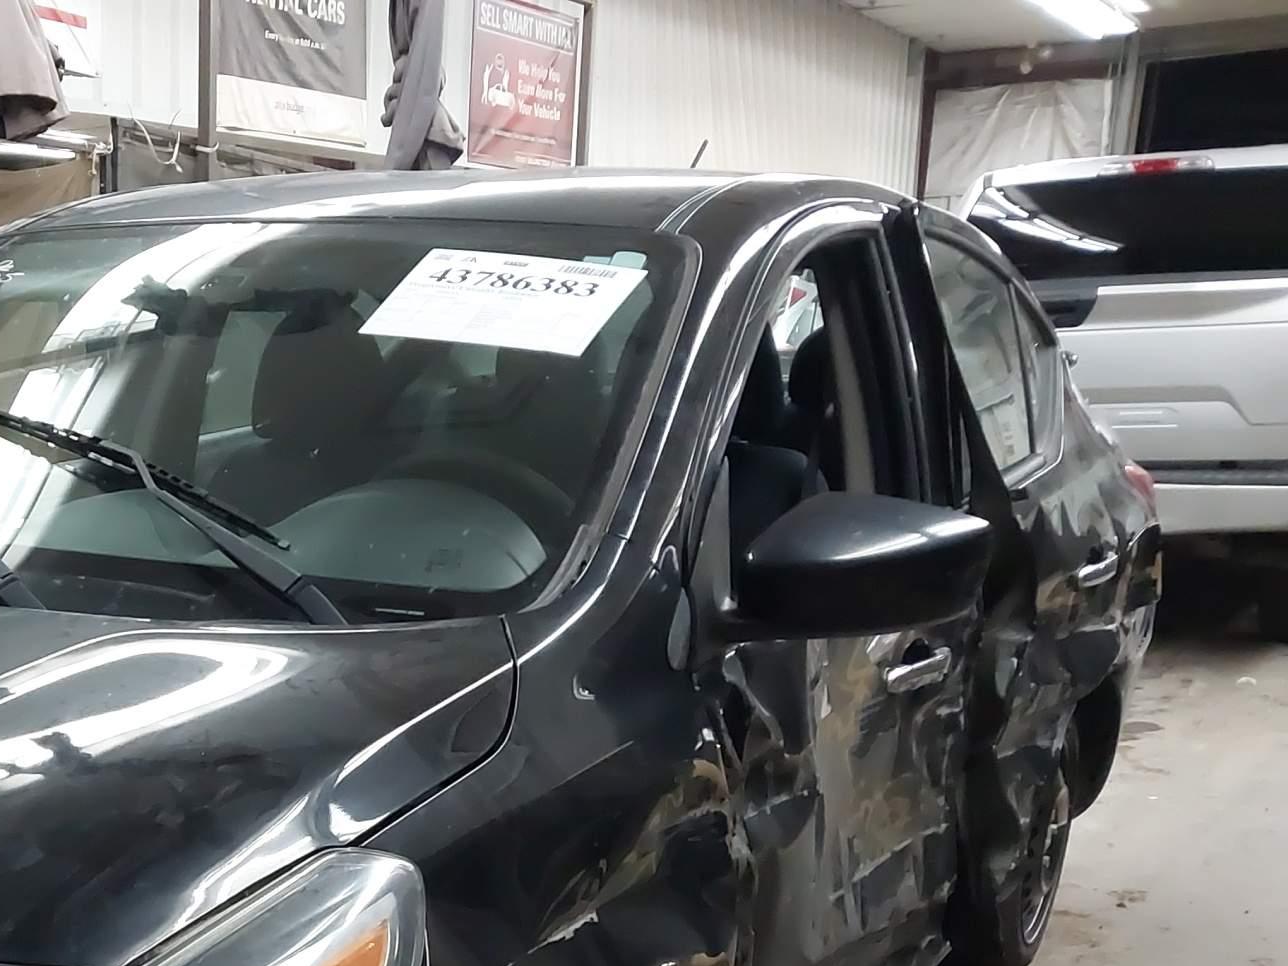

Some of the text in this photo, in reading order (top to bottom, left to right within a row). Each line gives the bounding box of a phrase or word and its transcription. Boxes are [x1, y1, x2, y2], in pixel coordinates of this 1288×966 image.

[307, 0, 345, 25] CARS
[480, 2, 501, 28] SELL
[502, 8, 534, 38] SMART
[535, 18, 557, 44] WITH
[518, 59, 530, 76] We
[548, 67, 561, 83] You
[517, 79, 566, 103] Earn More For
[518, 98, 561, 121] Your Vehicle
[428, 267, 600, 298] 43786383
